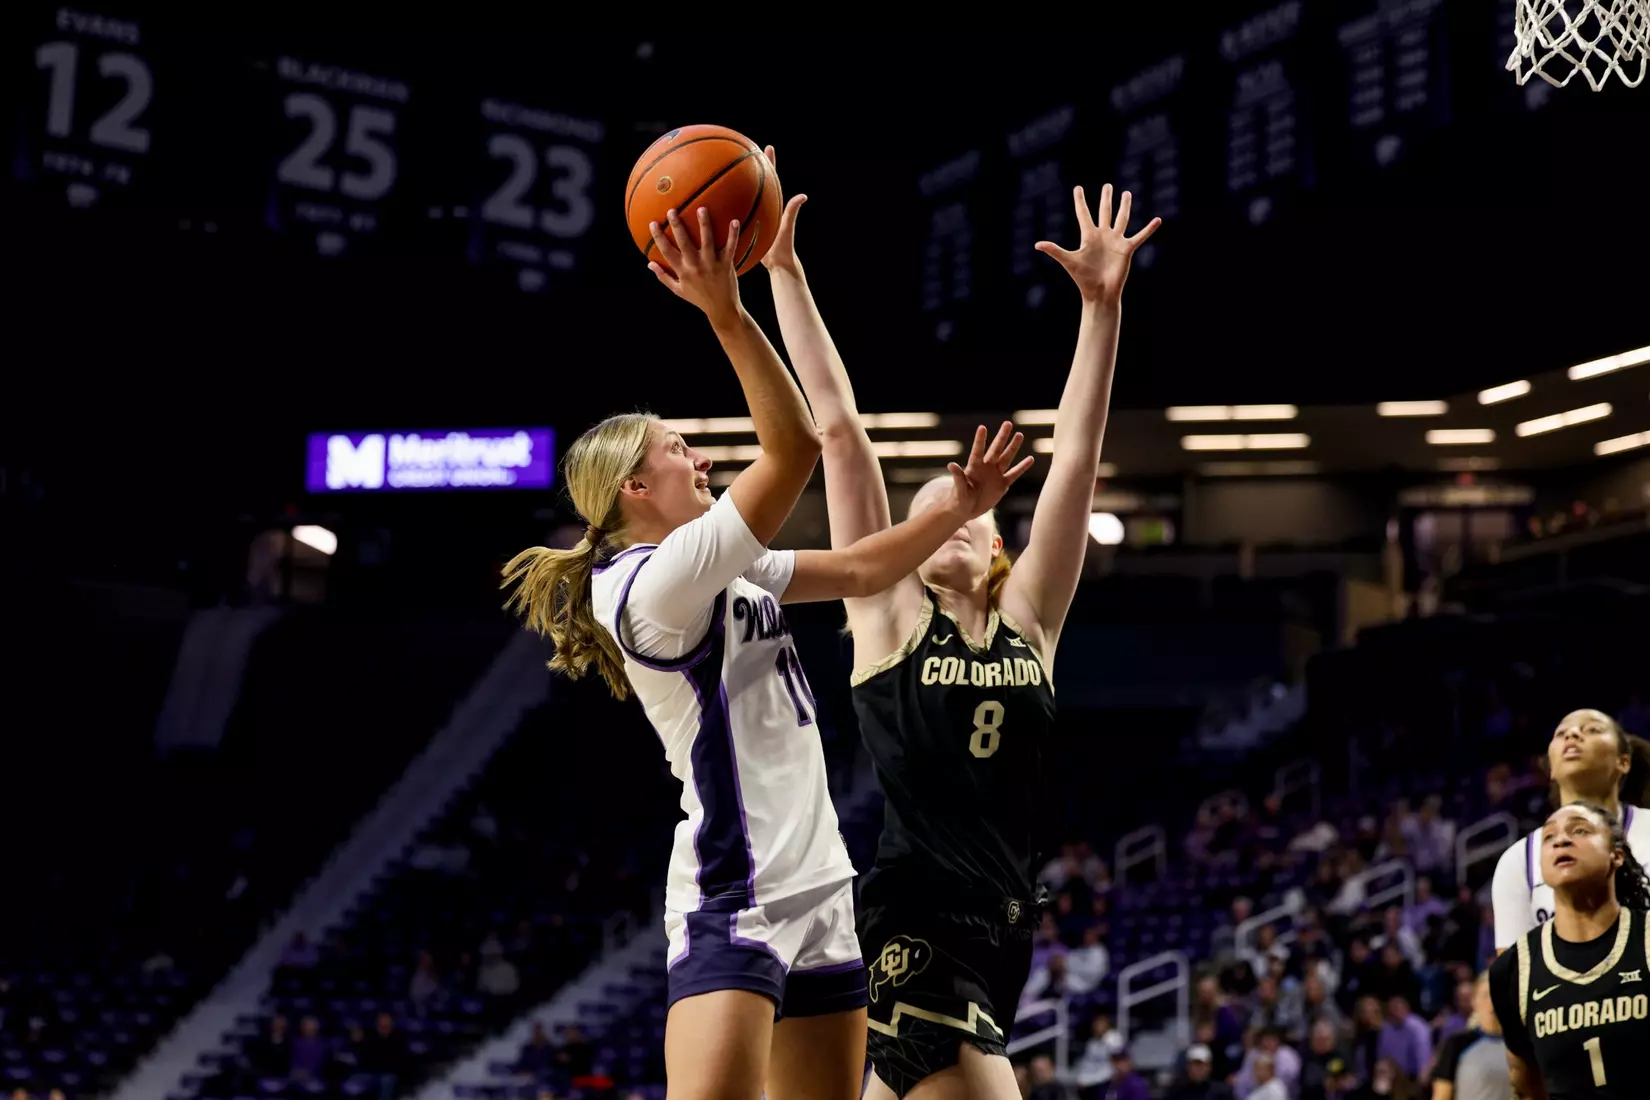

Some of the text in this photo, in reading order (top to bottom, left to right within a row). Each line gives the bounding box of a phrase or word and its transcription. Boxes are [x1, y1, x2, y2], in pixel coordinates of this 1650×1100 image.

[56, 7, 140, 45] EVANS
[35, 40, 154, 153] 12
[278, 92, 397, 201] 25
[482, 133, 595, 239] 23
[326, 434, 386, 489] M
[921, 656, 1041, 688] COLORADO
[968, 699, 1006, 759] 8
[880, 943, 911, 977] CU
[1534, 994, 1649, 1039] COLORADO
[1582, 1037, 1608, 1088] 1
